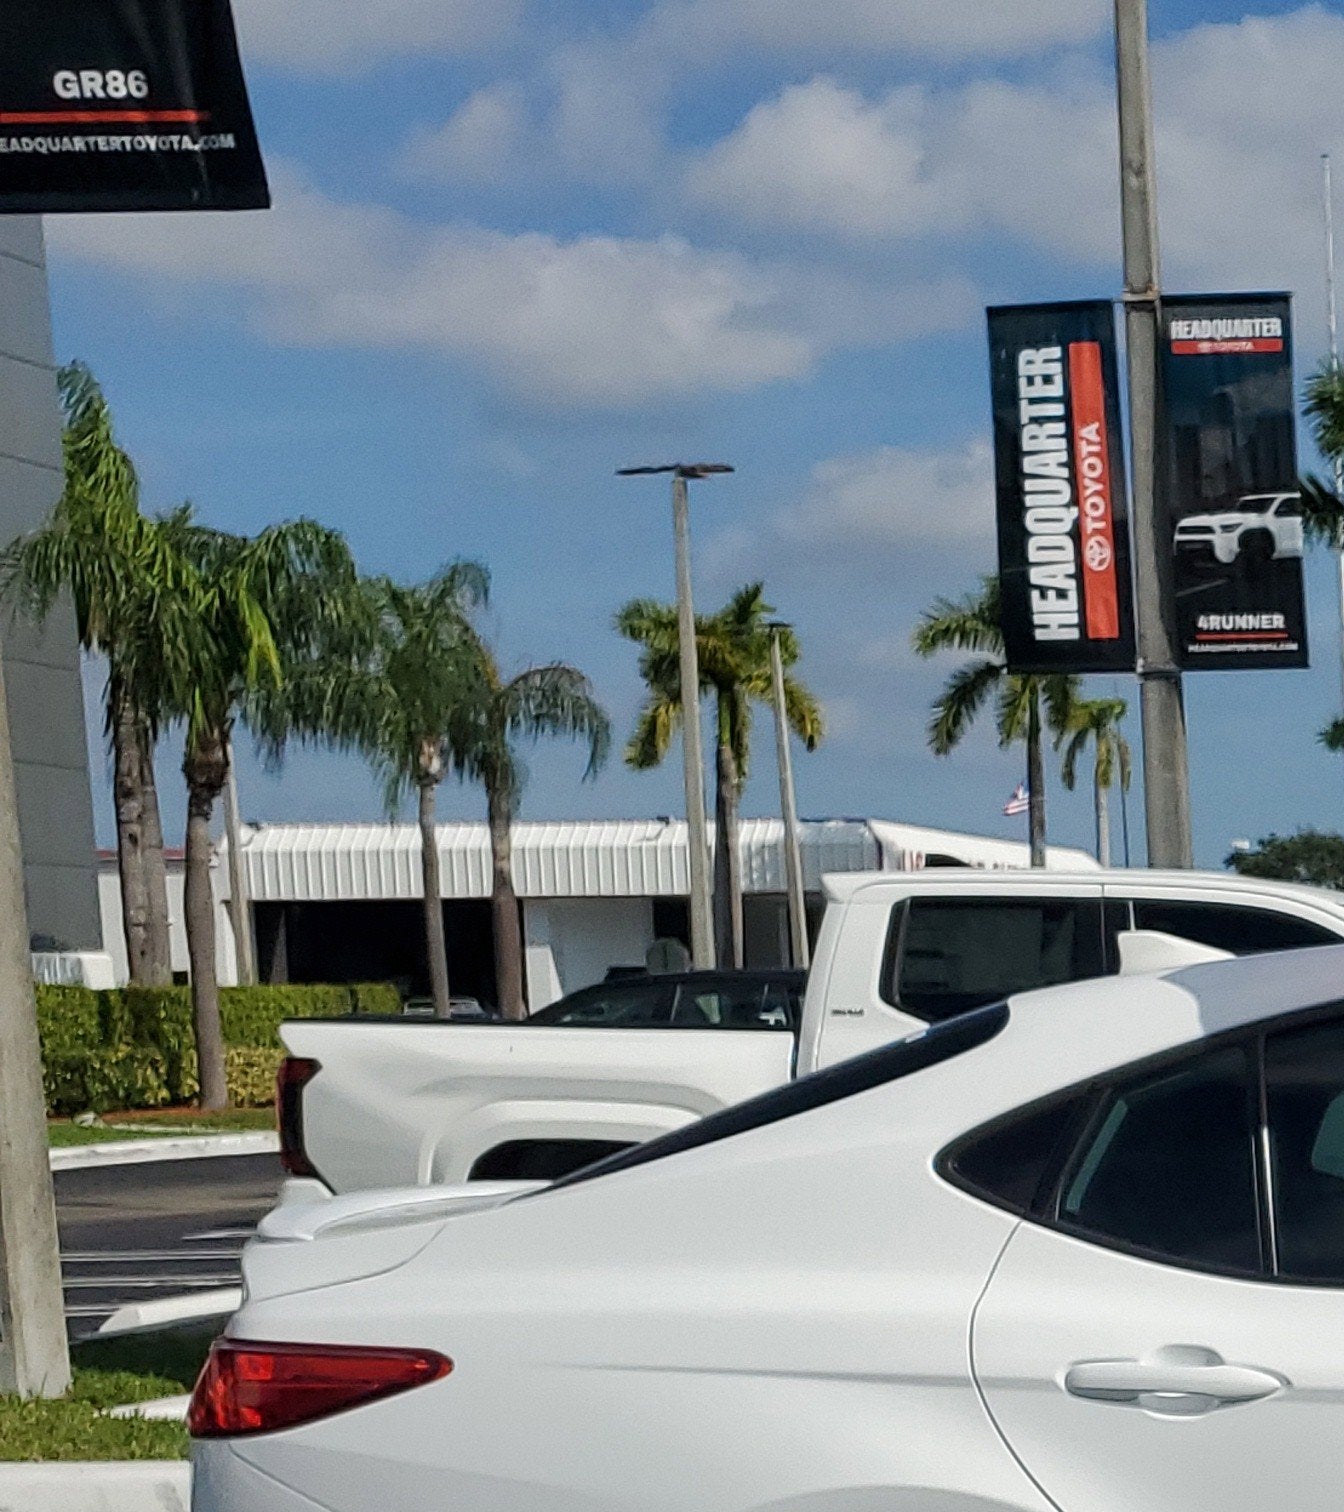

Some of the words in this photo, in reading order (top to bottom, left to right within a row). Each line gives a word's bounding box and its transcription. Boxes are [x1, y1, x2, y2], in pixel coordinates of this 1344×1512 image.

[53, 69, 149, 99] GR86
[0, 133, 236, 153] EADQUARTERTOYOTA.COM
[1077, 421, 1106, 533] TOYOTA
[1018, 346, 1081, 641] HEADQUARTER
[1197, 612, 1286, 630] 4RUNNER
